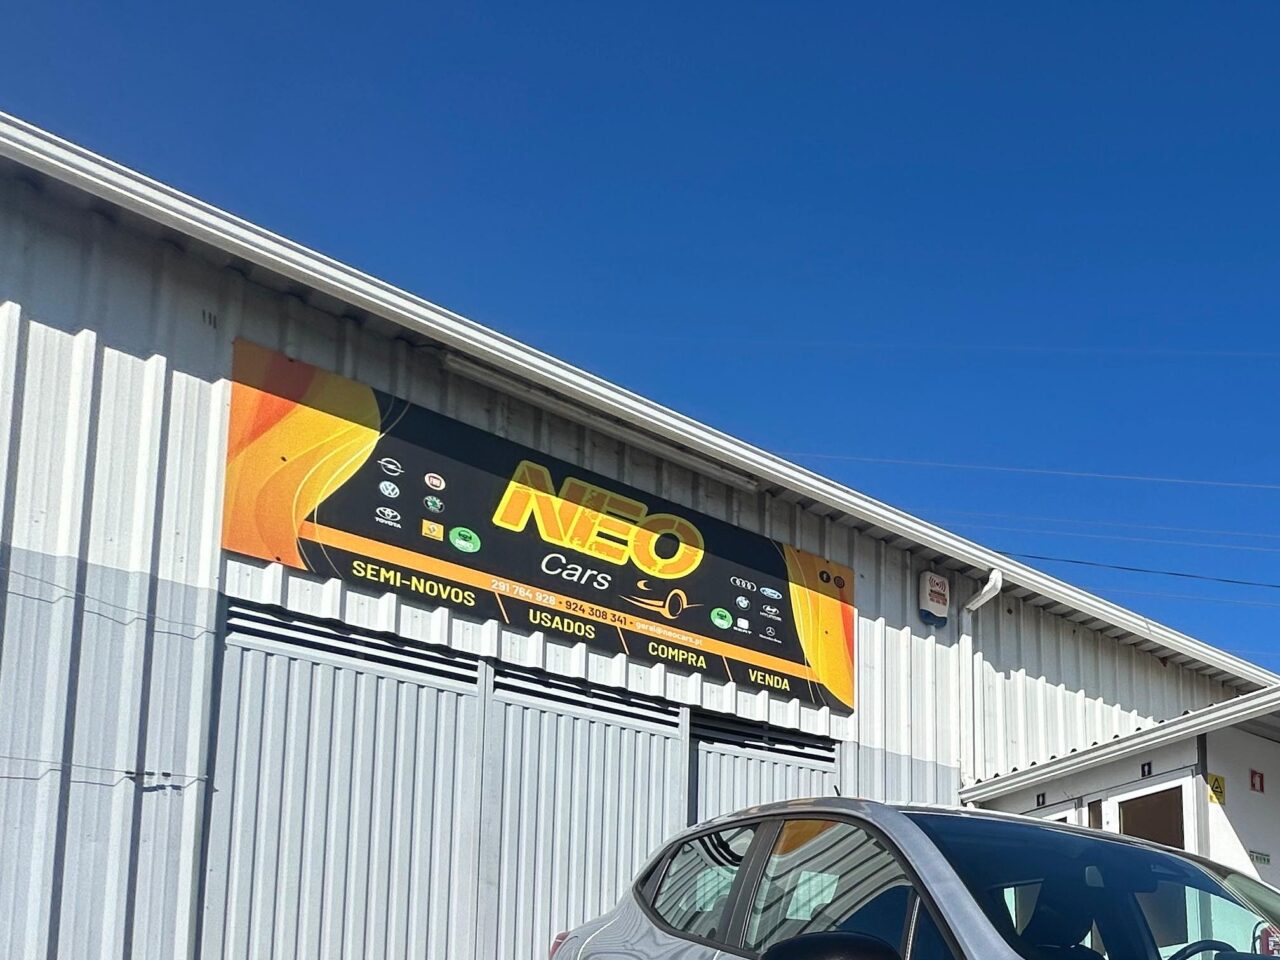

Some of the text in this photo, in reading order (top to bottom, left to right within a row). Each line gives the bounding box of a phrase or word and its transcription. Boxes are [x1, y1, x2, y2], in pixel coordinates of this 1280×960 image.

[374, 516, 402, 529] TOYOTA
[491, 459, 705, 580] NEO
[352, 560, 476, 607] SEMI-NOVOS
[540, 553, 612, 590] Cars
[491, 579, 510, 593] 291
[513, 585, 533, 600] 764
[535, 591, 556, 606] 928
[565, 600, 586, 614] 924
[588, 606, 608, 620] 308
[610, 613, 627, 626] 341
[528, 608, 596, 640] USADOS
[648, 641, 707, 669] COMPRA
[748, 668, 790, 692] VENDA
